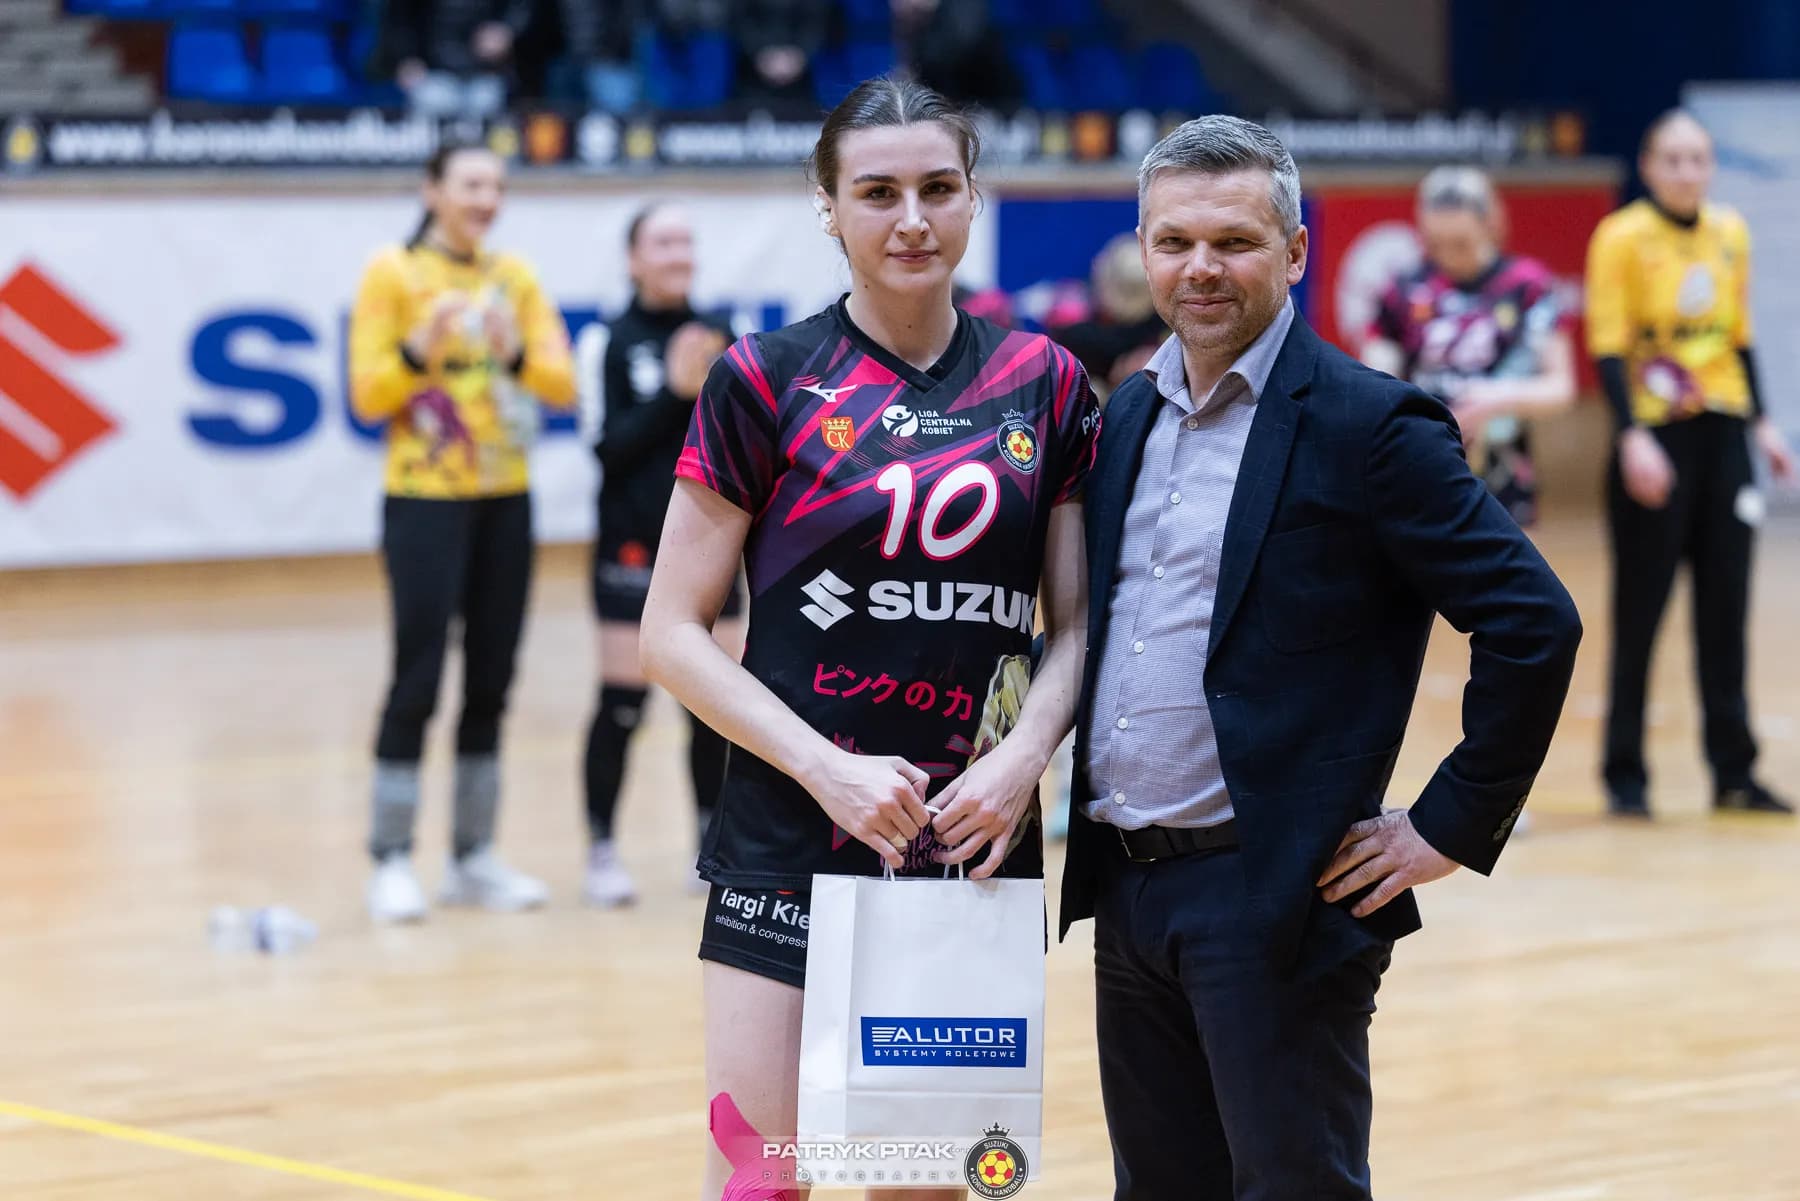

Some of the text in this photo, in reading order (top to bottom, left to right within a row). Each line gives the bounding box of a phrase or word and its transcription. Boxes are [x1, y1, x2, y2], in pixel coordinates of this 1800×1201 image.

[918, 410, 939, 418] LIGA
[920, 418, 973, 427] CENTRALNA
[826, 430, 851, 449] CK
[921, 427, 953, 435] KOBIET
[874, 460, 1000, 561] 10
[868, 580, 1037, 636] SUZUK
[720, 887, 810, 930] Targi Kie
[715, 914, 808, 949] exhibition & congress
[893, 1026, 1016, 1044] ALUTOR
[945, 1050, 1016, 1058] ROLETOWE
